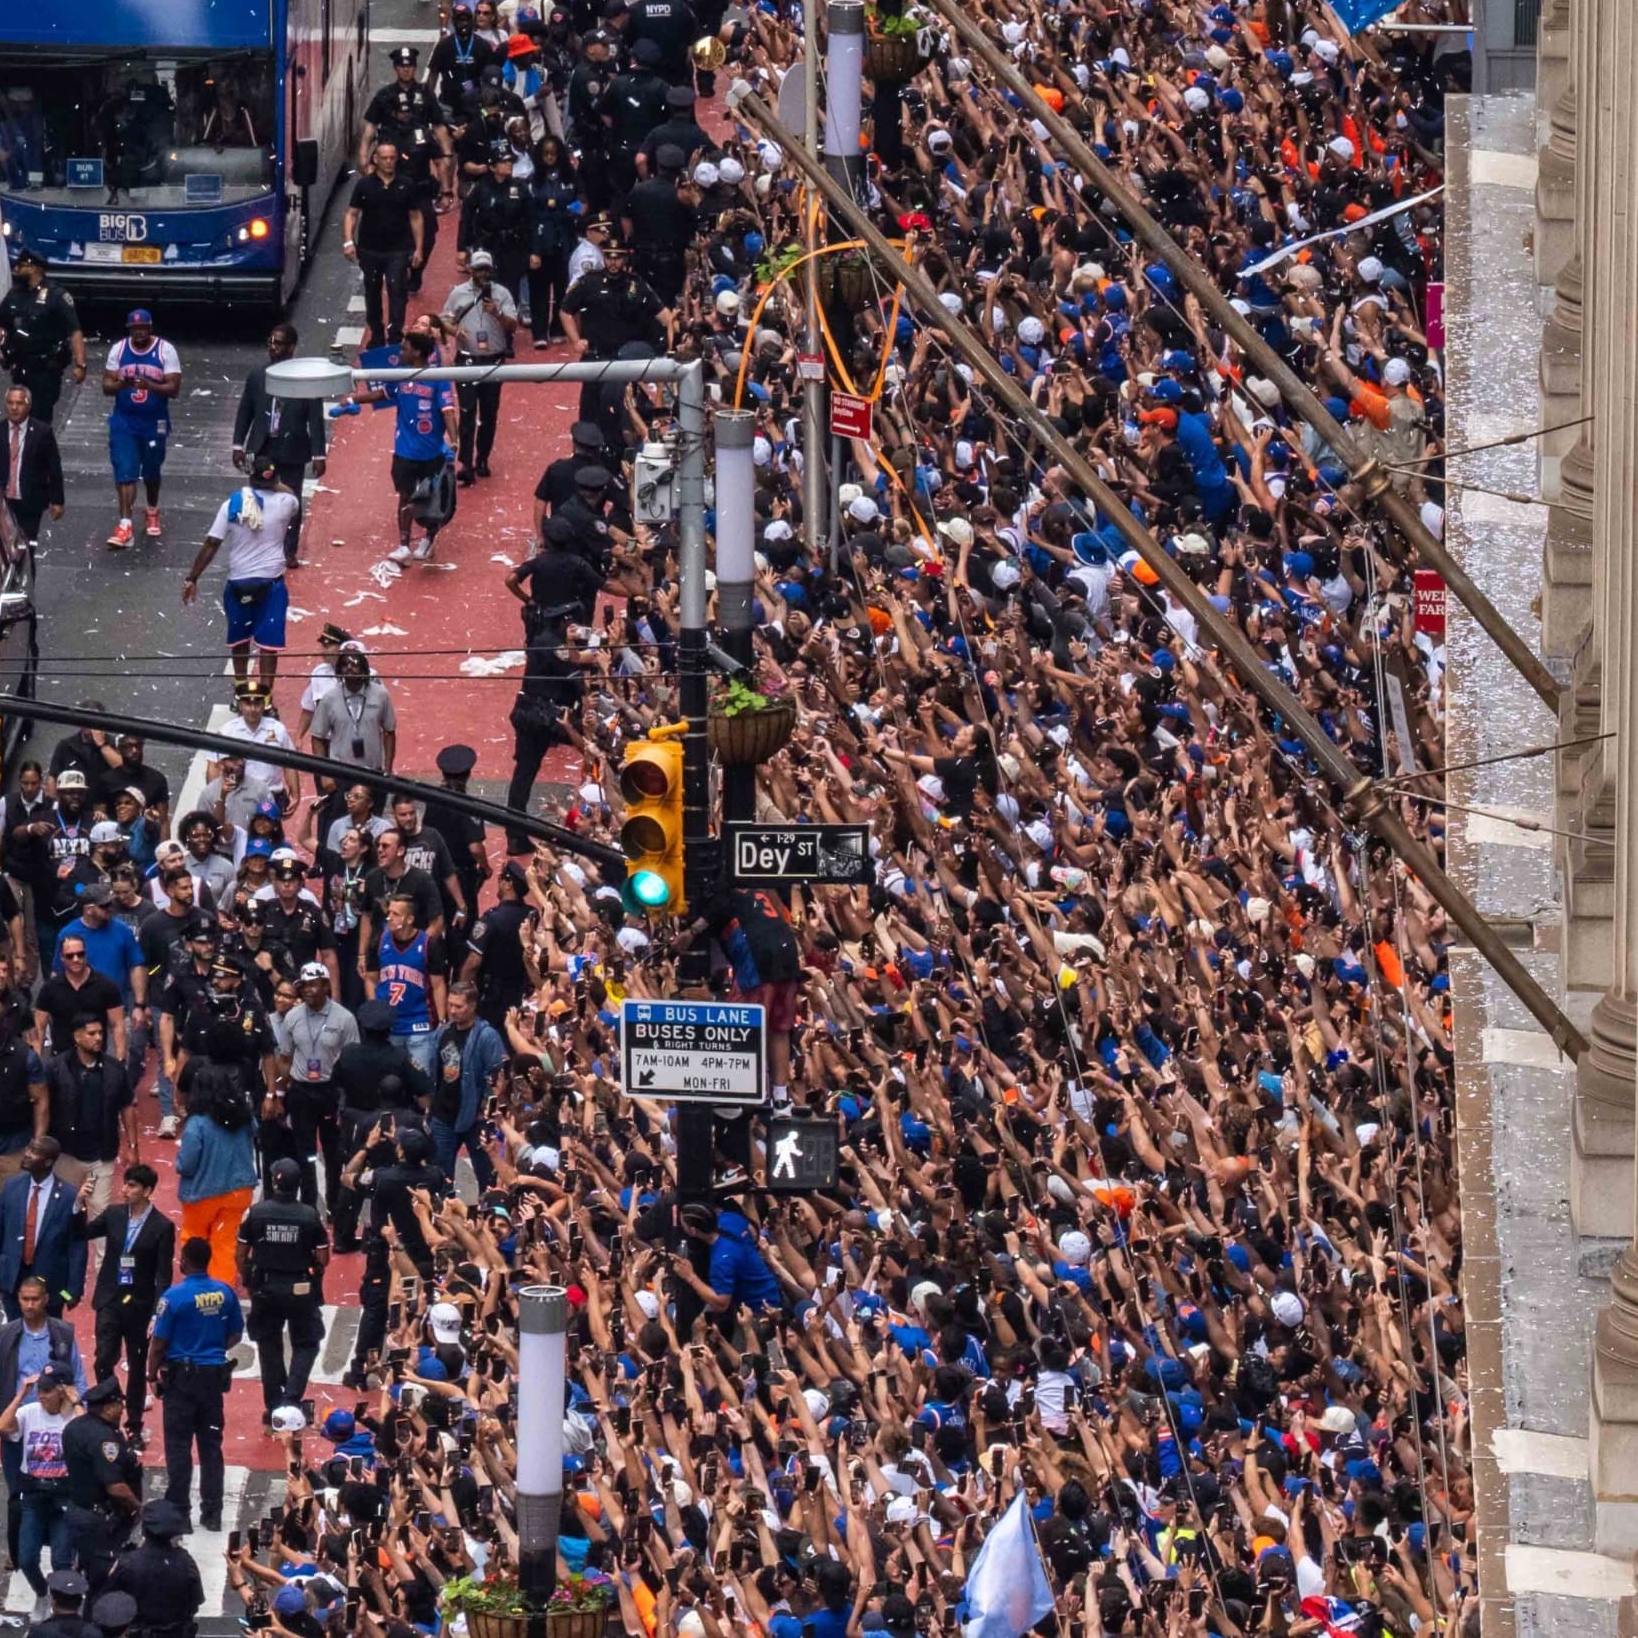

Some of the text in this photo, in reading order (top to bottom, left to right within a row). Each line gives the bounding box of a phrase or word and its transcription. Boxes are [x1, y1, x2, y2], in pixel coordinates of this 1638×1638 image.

[645, 4, 671, 15] NYPD
[99, 214, 126, 228] BIG
[99, 229, 126, 241] BUS
[776, 833, 796, 844] 1-29
[741, 841, 814, 875] Dey ST
[389, 982, 407, 1007] 7
[665, 1006, 751, 1024] BUS LANE
[635, 1023, 752, 1043] BUSES ONLY
[664, 1040, 694, 1050] RIGHT
[699, 1041, 732, 1051] TURNS
[635, 1053, 751, 1070] 7AM-10AM 4PM-7PM
[683, 1076, 731, 1090] MON-FRI
[265, 1230, 300, 1243] SHERIFF
[194, 1291, 225, 1308] NYPD
